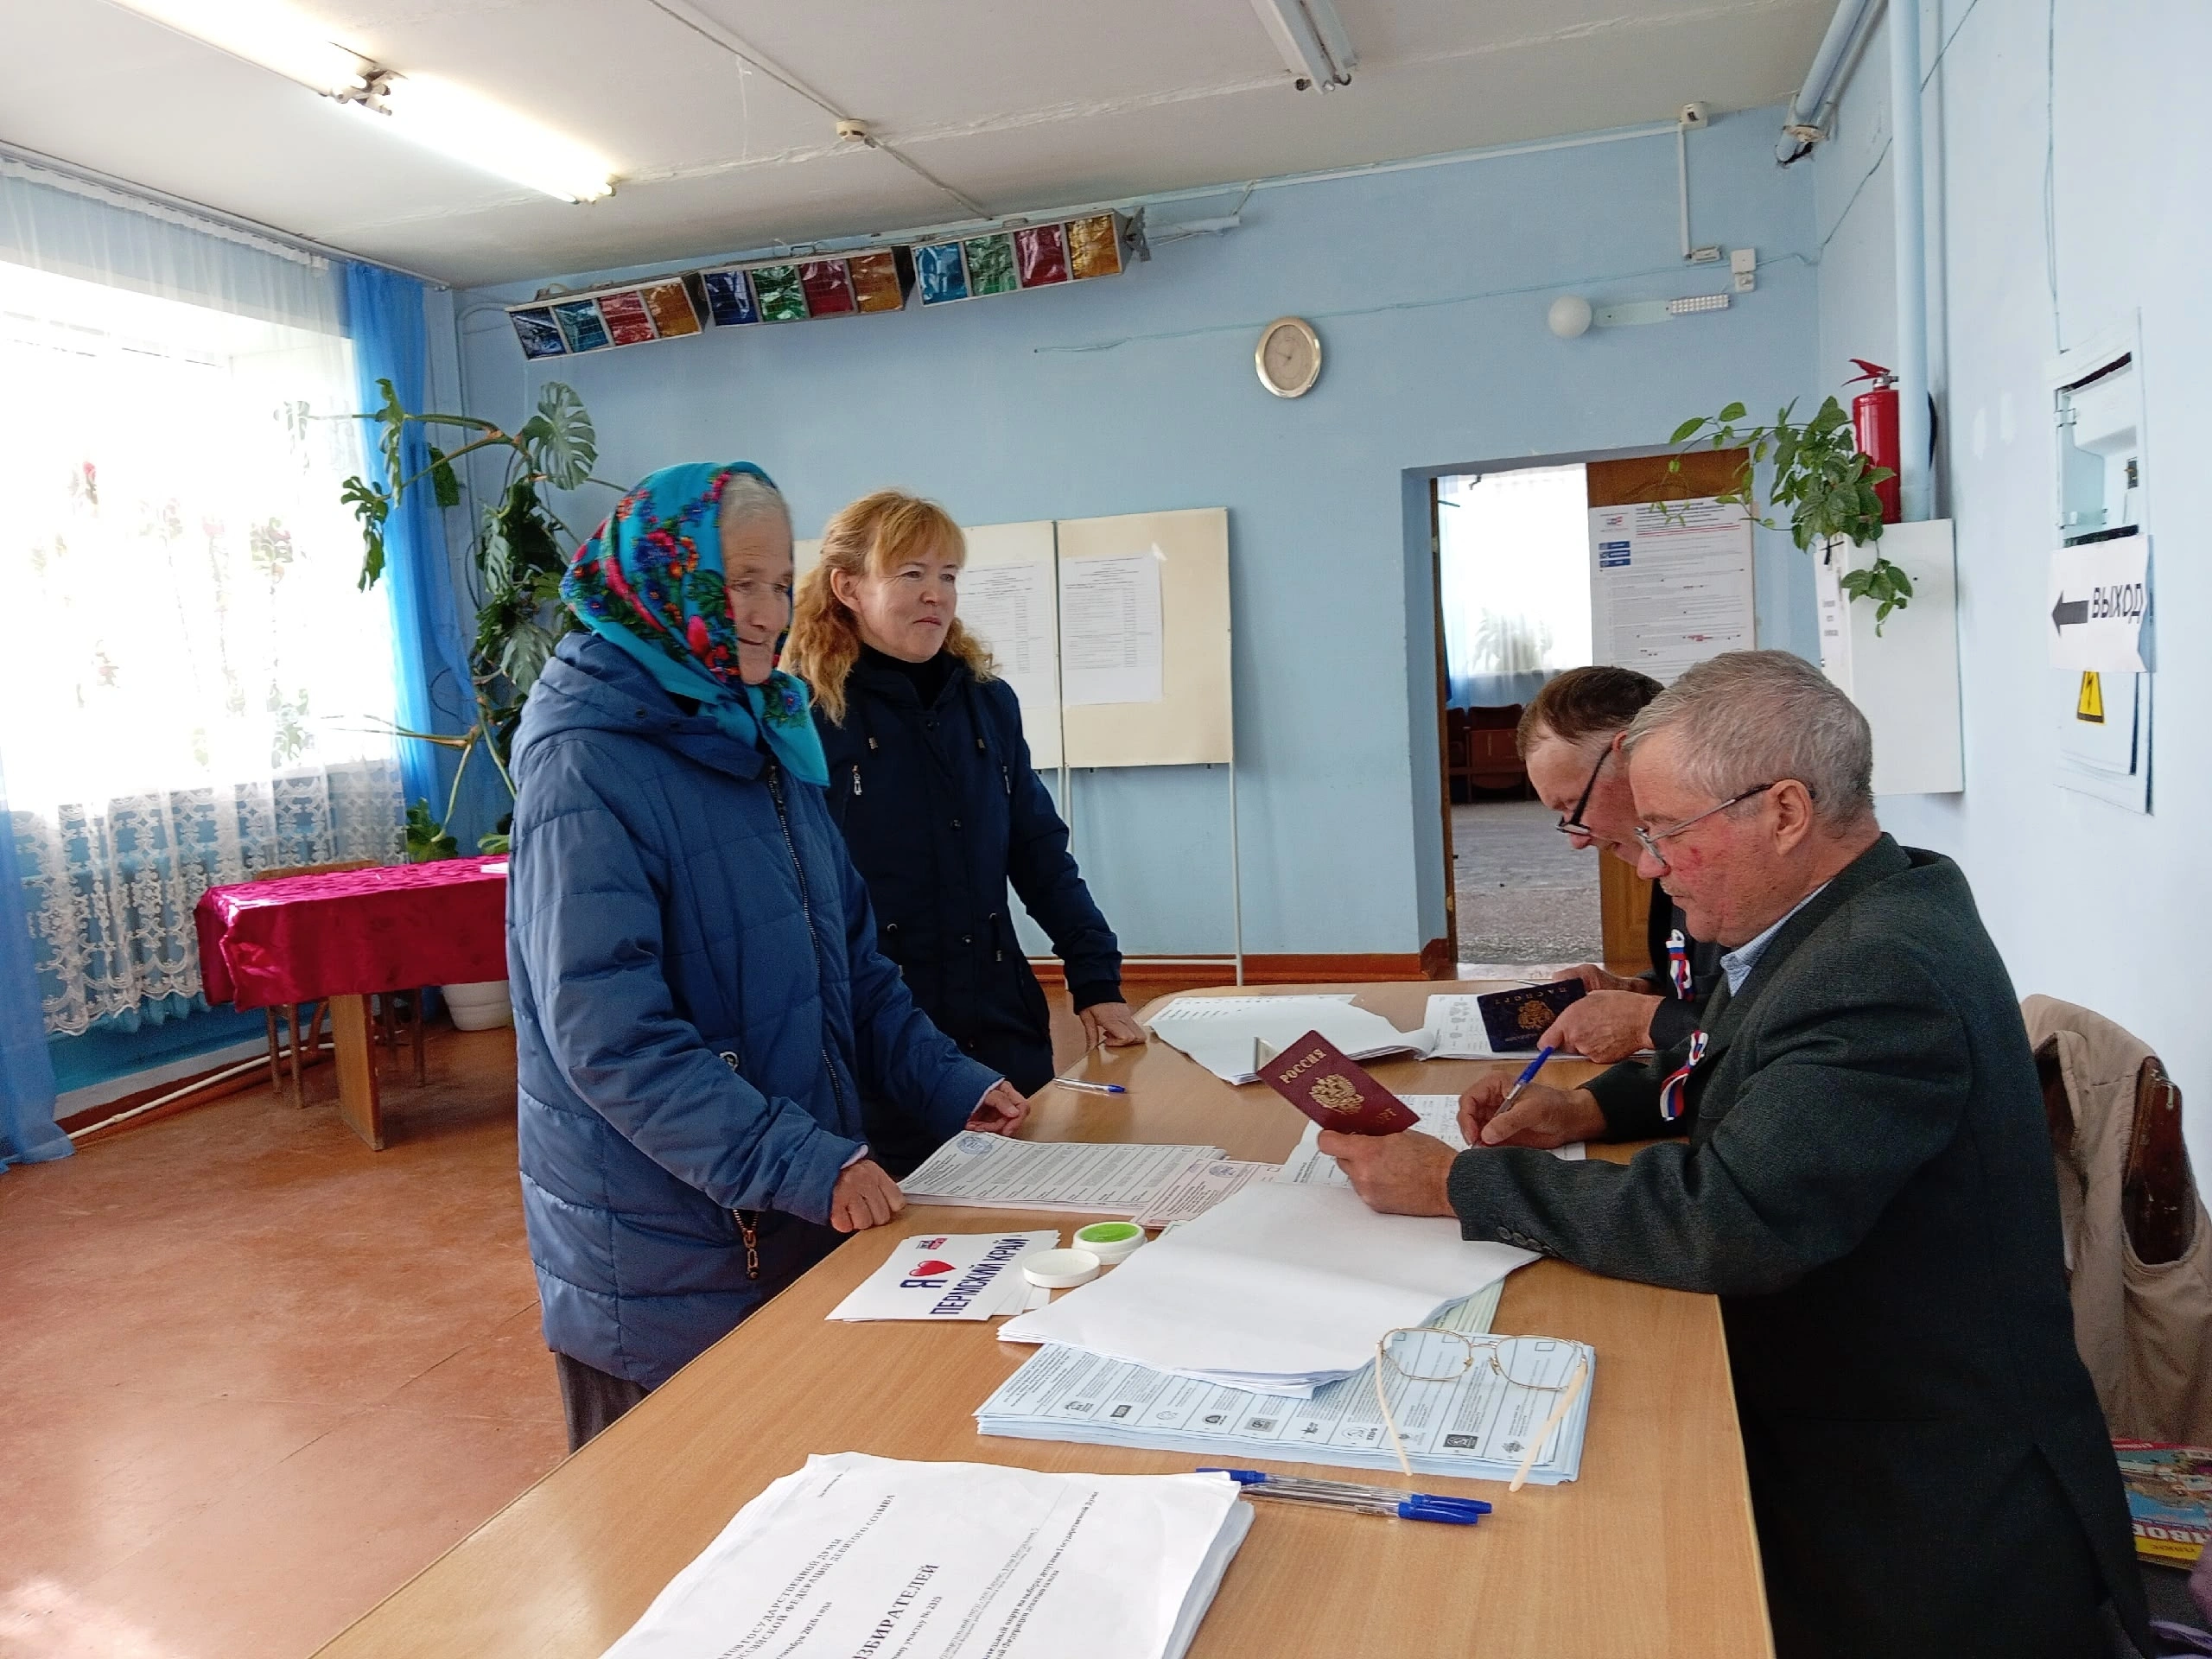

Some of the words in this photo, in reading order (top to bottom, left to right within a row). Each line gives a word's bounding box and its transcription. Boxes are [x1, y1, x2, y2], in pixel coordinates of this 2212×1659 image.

[2090, 582, 2144, 625] ВЫХОД
[1279, 1048, 1327, 1084] РОССИЯ
[899, 1279, 948, 1288] Я
[929, 1263, 1007, 1315] ПЕРМСКИЙ
[785, 1563, 833, 1612] ФЕДЕРАЦИИ
[830, 1527, 868, 1562] ДЕВЯТОГО
[866, 1495, 895, 1526] СОЗЫВА
[741, 1560, 824, 1643] ГОСУДАРСТВЕННОЙ
[817, 1538, 842, 1560] ДУМЫ
[800, 1618, 819, 1635] 2026
